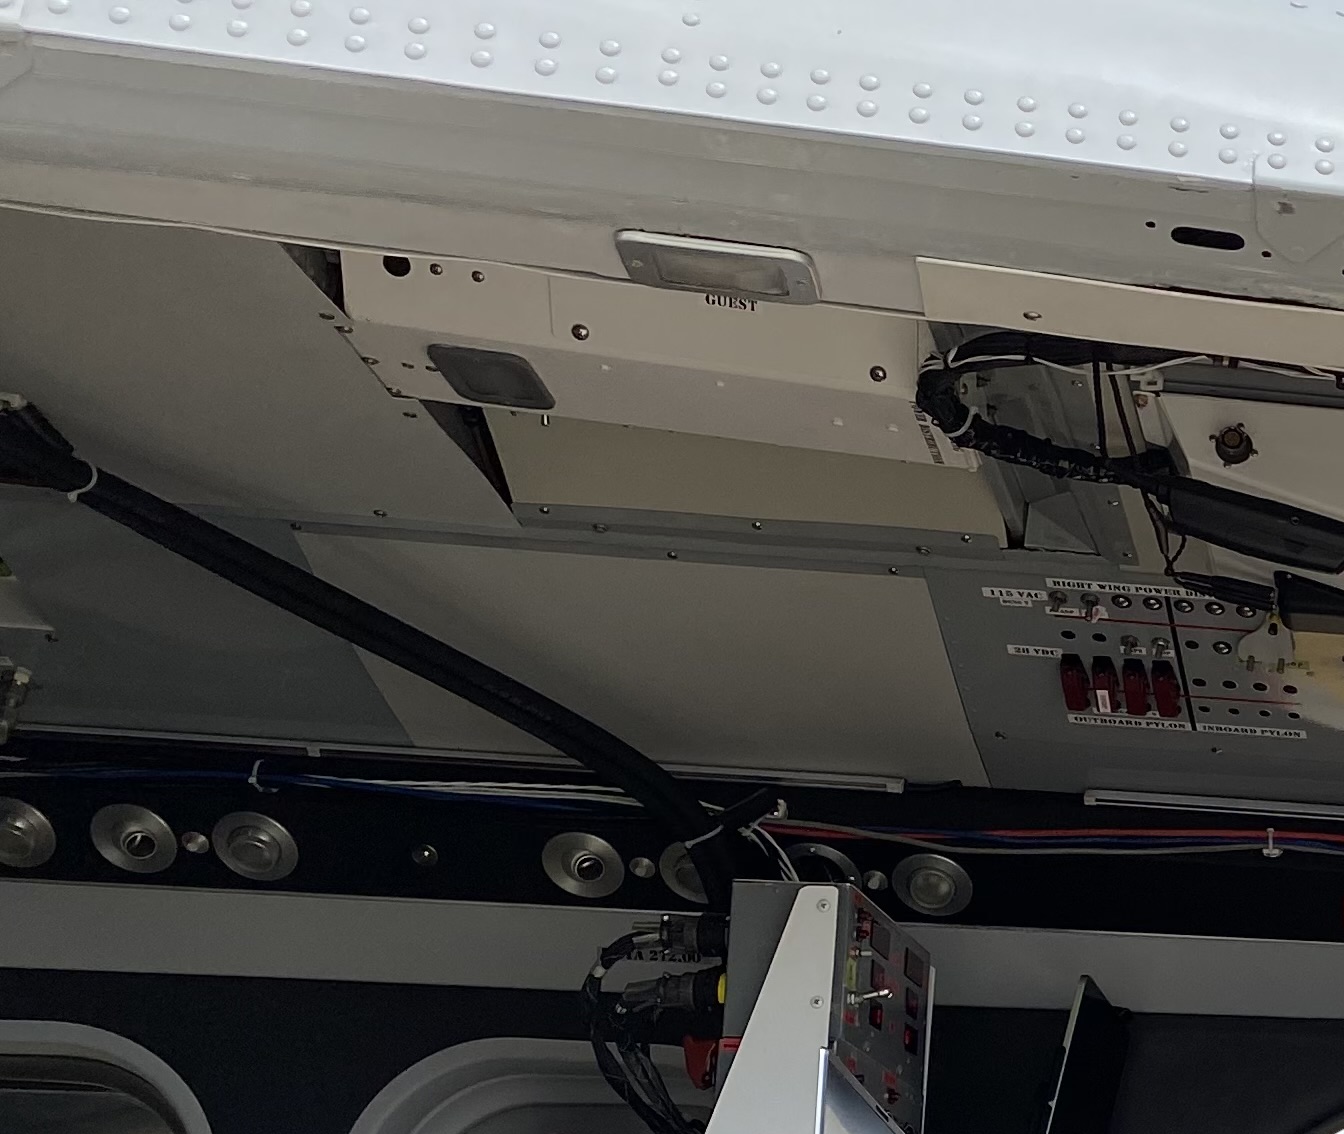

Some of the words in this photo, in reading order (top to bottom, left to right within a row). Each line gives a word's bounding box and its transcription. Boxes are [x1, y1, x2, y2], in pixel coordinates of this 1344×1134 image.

[705, 293, 758, 311] GUEST
[990, 588, 1014, 598] 115
[1017, 590, 1041, 599] VAC
[1098, 583, 1131, 593] WING
[1135, 586, 1181, 596] POWER
[1074, 716, 1142, 727] OUTBOARD
[1146, 721, 1187, 730] PYLON
[1202, 725, 1257, 735] INBOARD
[1260, 729, 1301, 739] PYLON
